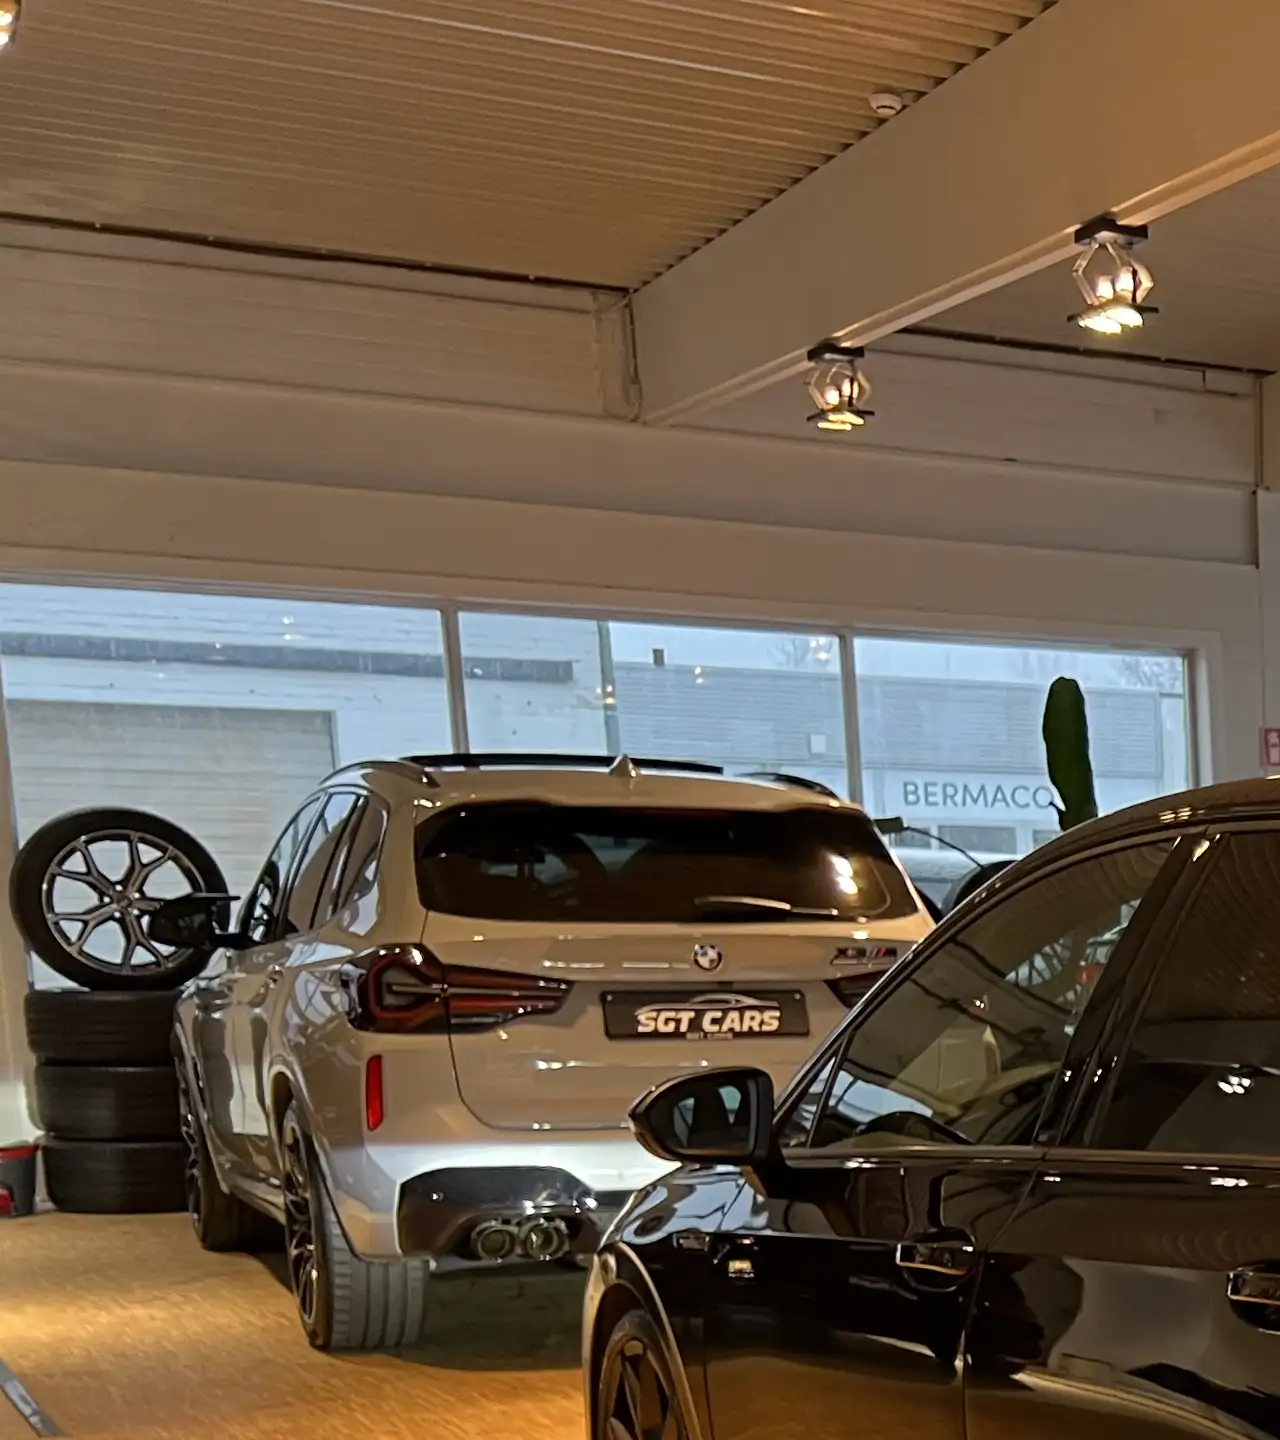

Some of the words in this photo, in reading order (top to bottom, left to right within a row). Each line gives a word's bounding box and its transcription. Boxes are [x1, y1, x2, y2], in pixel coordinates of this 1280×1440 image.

[902, 781, 1055, 810] BERMACO
[635, 1009, 696, 1033] SGT
[701, 1009, 781, 1033] CARS
